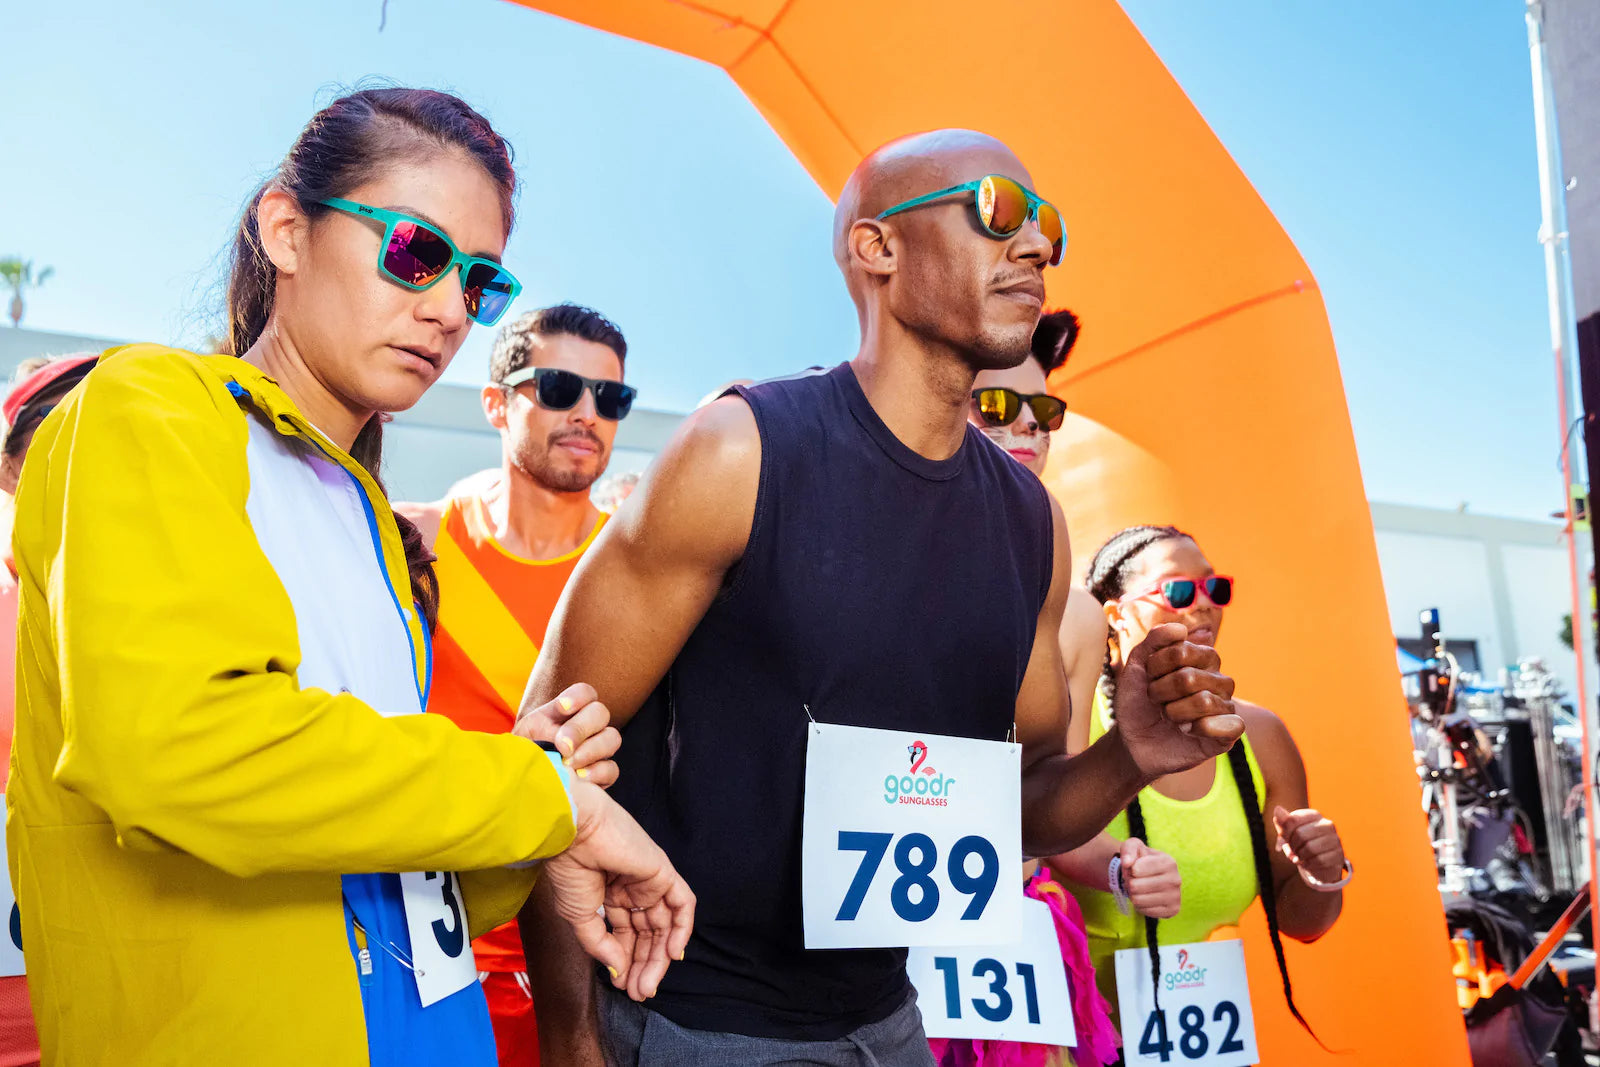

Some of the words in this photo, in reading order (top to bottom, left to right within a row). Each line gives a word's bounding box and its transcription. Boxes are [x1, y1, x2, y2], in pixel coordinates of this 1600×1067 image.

[884, 773, 956, 804] goodr
[899, 796, 948, 807] SUNGLASSES
[834, 830, 1000, 922] 789
[933, 956, 1041, 1025] 131
[1165, 967, 1207, 991] goodr
[1138, 1000, 1245, 1063] 482
